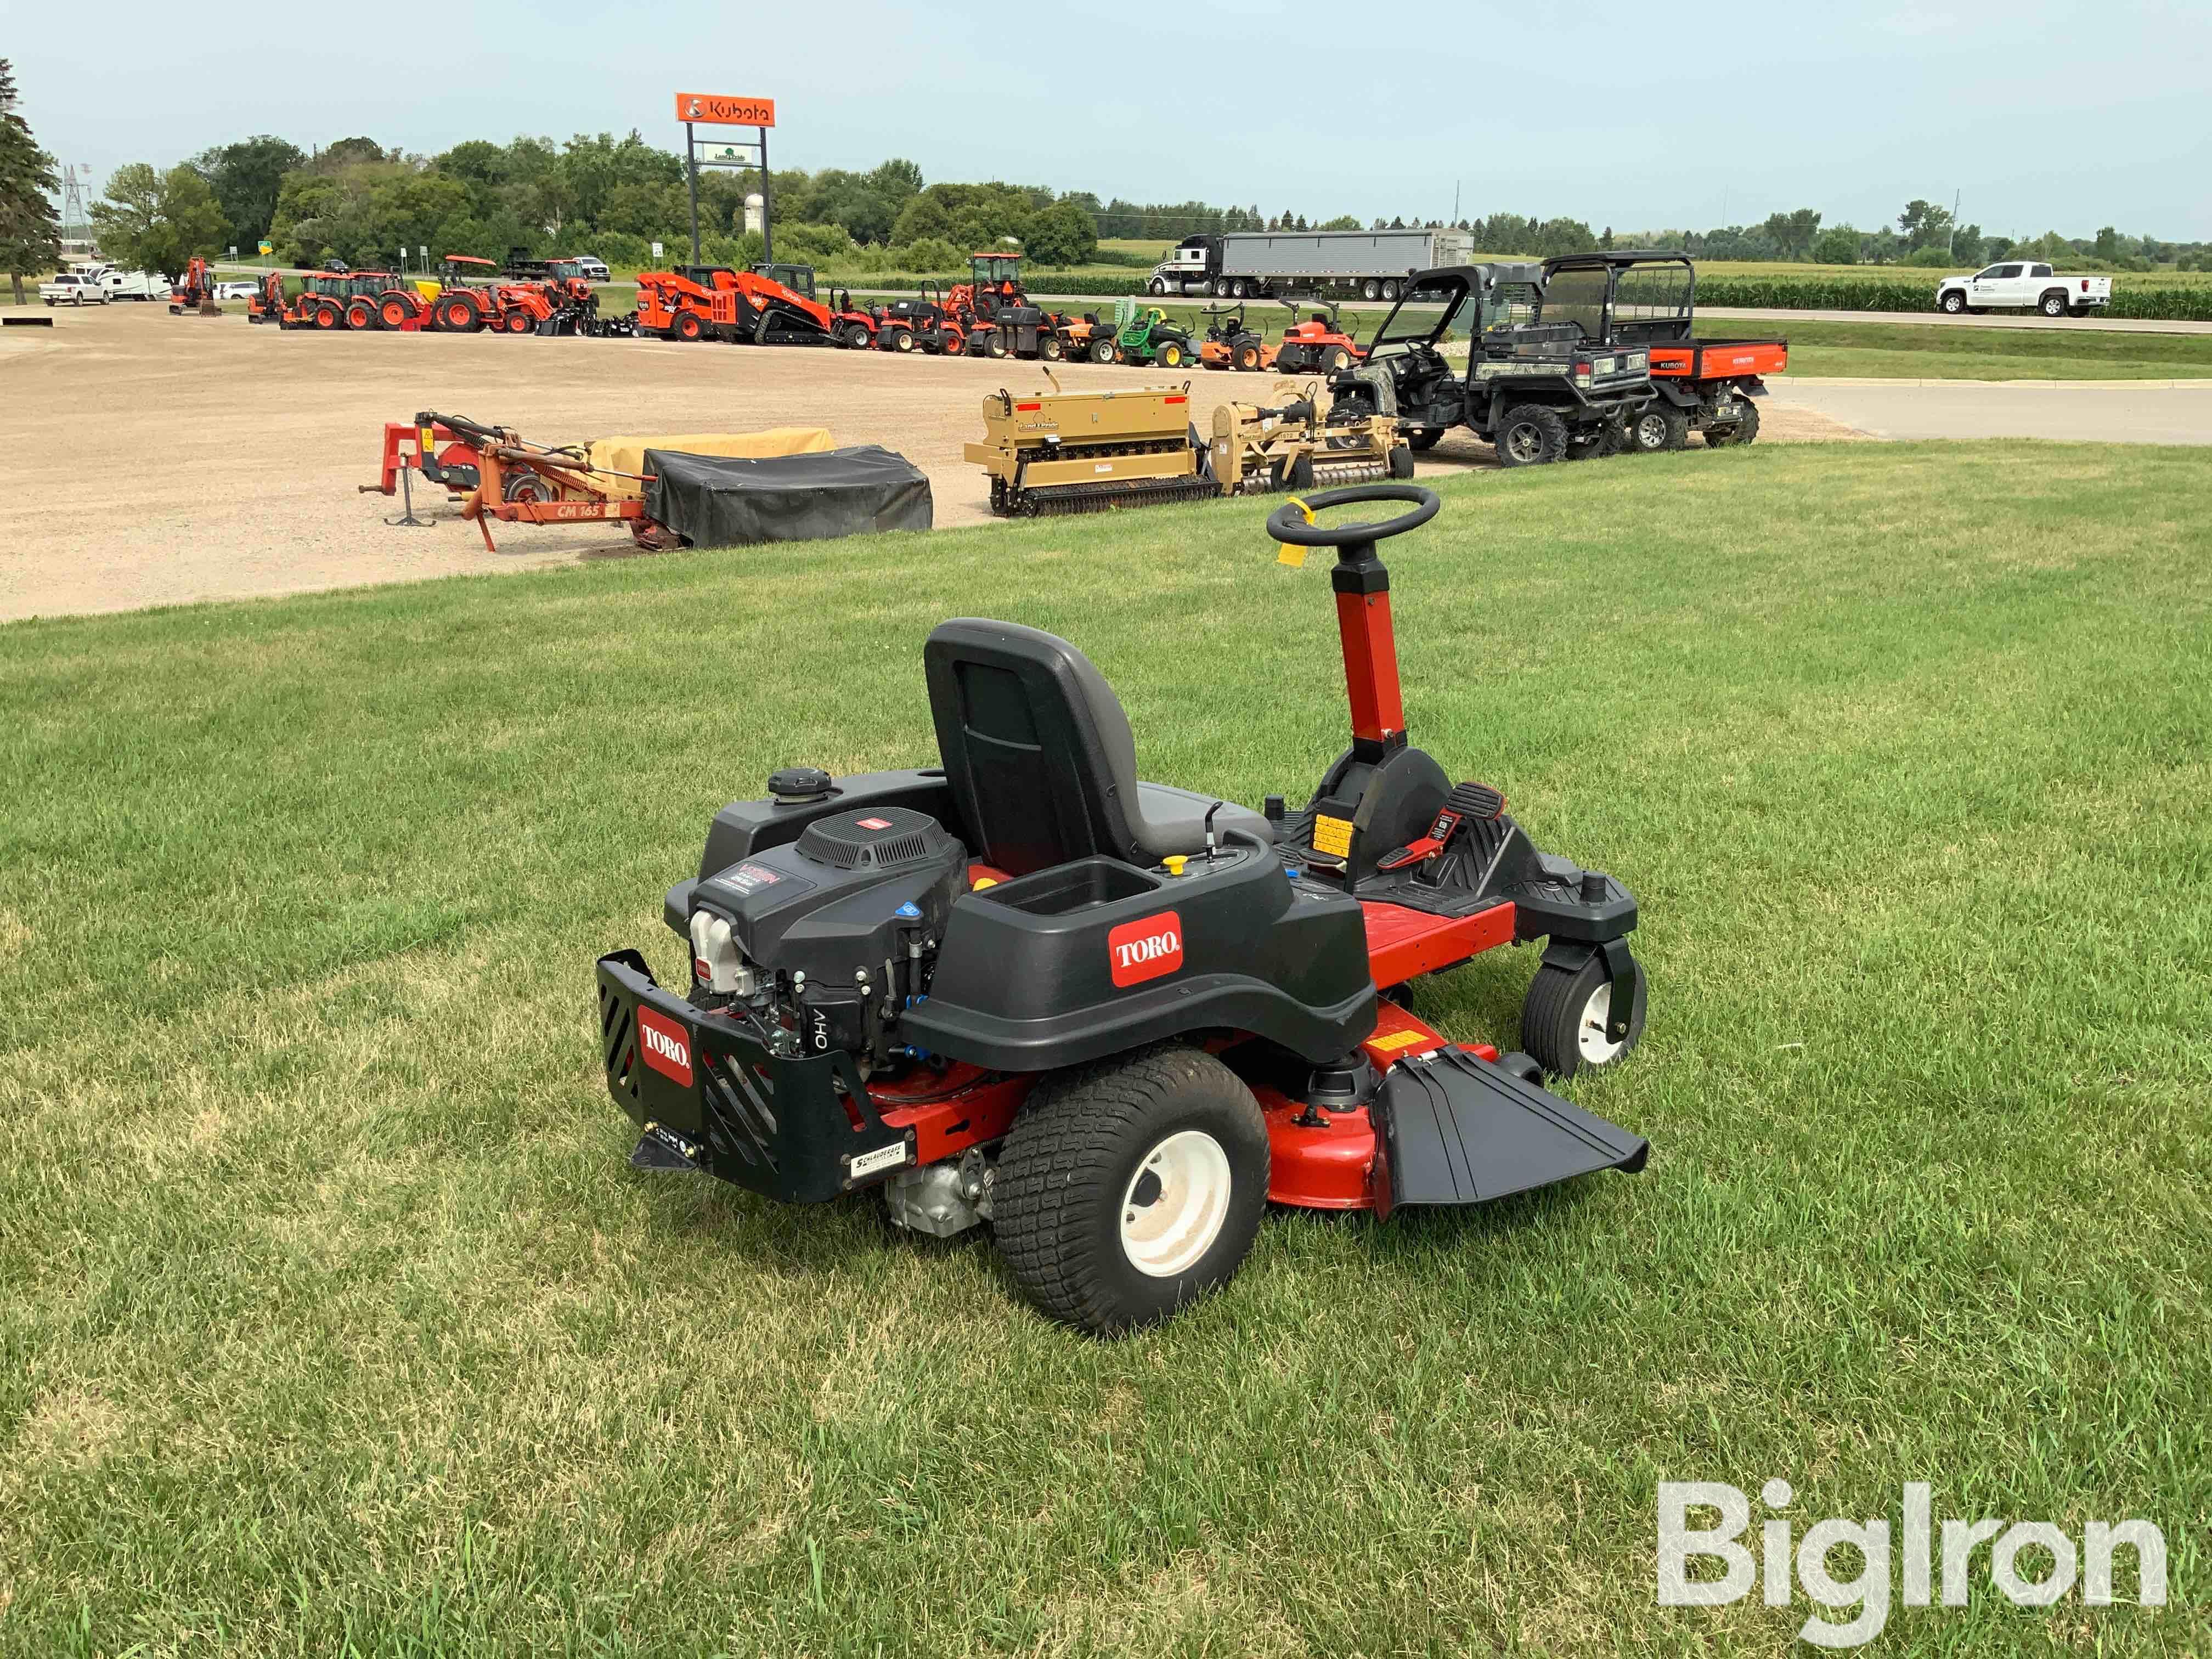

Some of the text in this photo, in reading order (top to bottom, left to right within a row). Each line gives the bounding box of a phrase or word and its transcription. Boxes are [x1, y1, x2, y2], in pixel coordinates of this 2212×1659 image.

[709, 101, 769, 121] Kubota
[557, 505, 600, 518] CM 165
[1115, 931, 1177, 968] TORO
[642, 1024, 687, 1066] TORO
[813, 1008, 827, 1049] OHV
